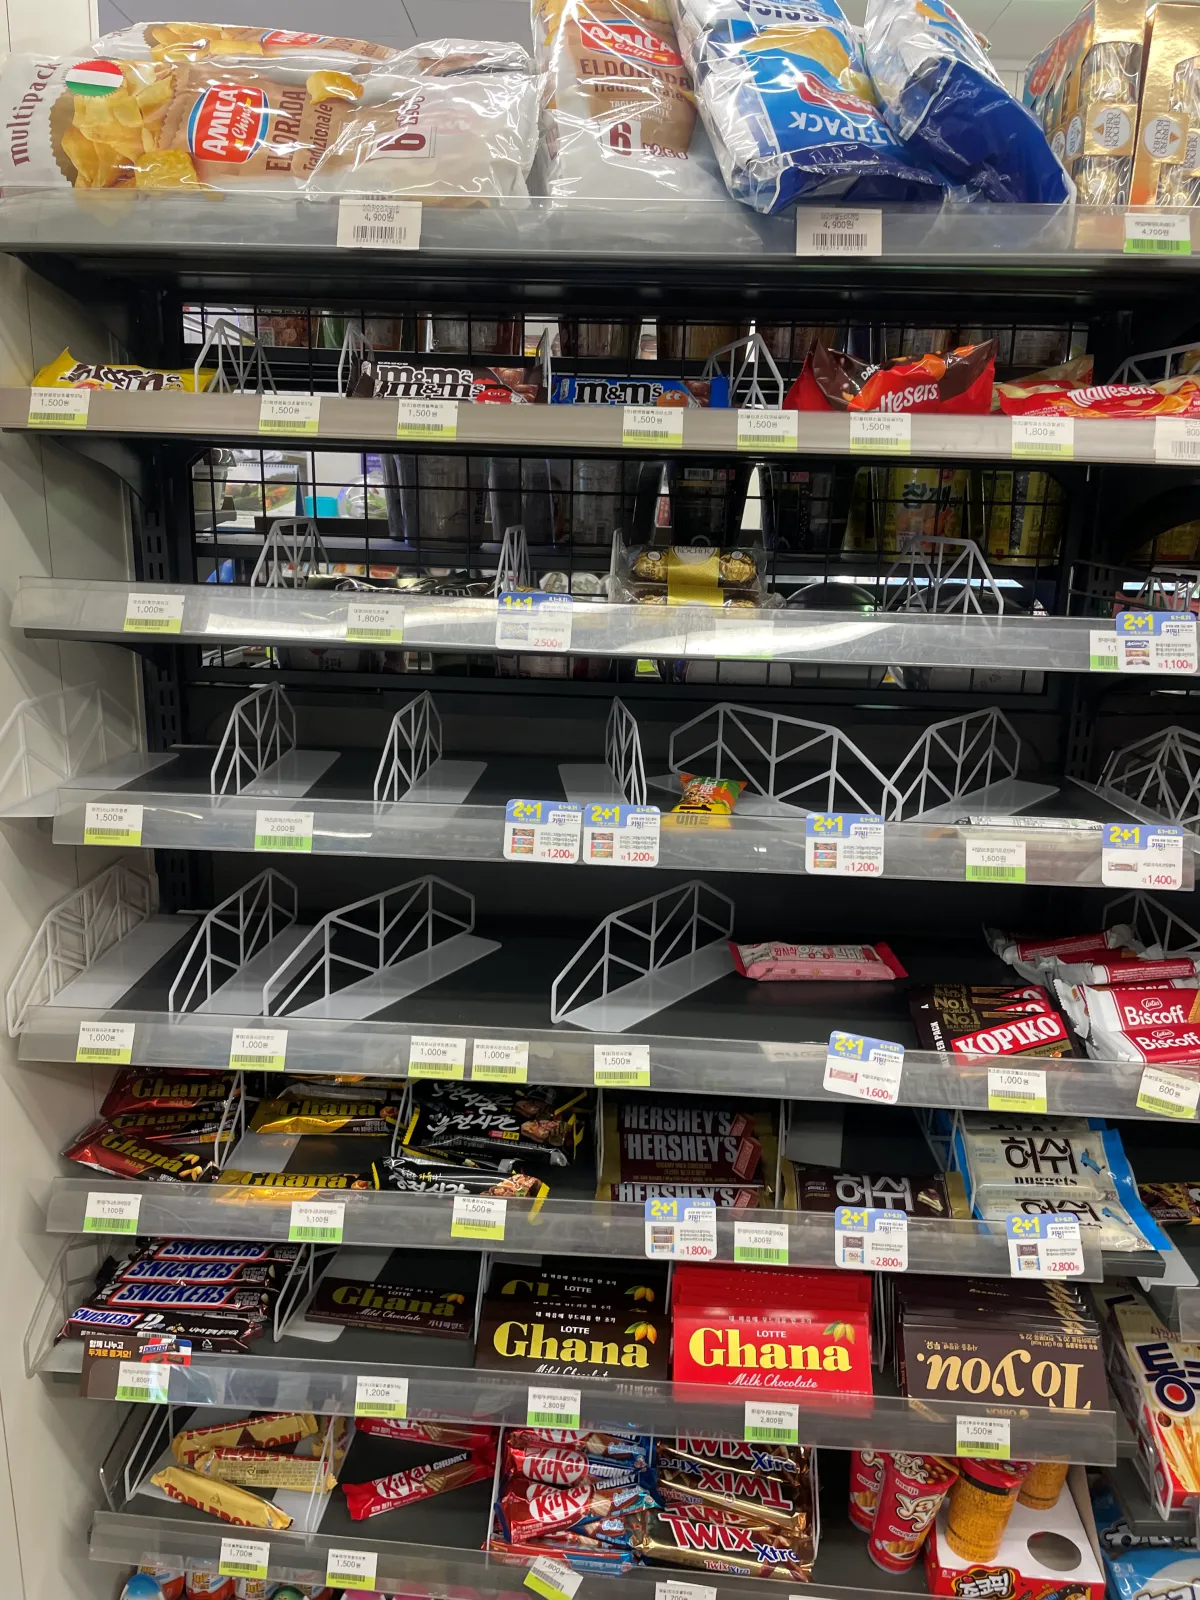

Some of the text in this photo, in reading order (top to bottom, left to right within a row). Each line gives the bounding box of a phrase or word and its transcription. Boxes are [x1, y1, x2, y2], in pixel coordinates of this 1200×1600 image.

[588, 26, 677, 54] AMICA
[6, 62, 62, 167] multipack
[202, 89, 239, 156] AMICA
[265, 90, 307, 172] ELORADA
[1111, 112, 1121, 148] ROCHER
[1152, 118, 1162, 153] ROCHER
[609, 121, 633, 157] 6
[1141, 228, 1170, 237] 4,700원
[376, 365, 474, 384] m&m's
[385, 381, 486, 399] m&m's
[575, 380, 663, 404] m&m's
[40, 398, 69, 408] 1,500원
[270, 406, 300, 415] 1,500원
[408, 409, 438, 418] 1,500원
[633, 416, 663, 425] 1,500원
[749, 421, 778, 429] 1,500원
[861, 423, 891, 431] 1,500원
[1024, 428, 1055, 438] 1,800원
[136, 606, 164, 614] 1,000원
[503, 596, 533, 613] 1+1
[357, 615, 385, 623] 1,800원
[1123, 614, 1154, 630] 2+1
[534, 638, 563, 648] 2,500원
[1164, 660, 1193, 669] 1,100원
[513, 801, 542, 818] 2+1
[591, 805, 620, 822] 2+1
[96, 814, 124, 822] 1,500원
[813, 816, 843, 832] 2+1
[1109, 826, 1140, 843] 2+1
[547, 848, 574, 859] 1,200원
[627, 852, 654, 863] 1,200원
[981, 854, 1007, 863] 1,600원
[851, 862, 880, 873] 1,200원
[1148, 874, 1177, 885] 1,400원
[934, 996, 969, 1009] No.1
[942, 1013, 981, 1026] No.1
[1124, 1005, 1183, 1026] Biscoff
[931, 1021, 943, 1039] PACK
[955, 1016, 1061, 1058] KOPIKO
[89, 1034, 115, 1042] 1,000원
[241, 1041, 268, 1049] 1,000원
[834, 1035, 864, 1055] 2+1
[1136, 1032, 1200, 1050] Biscoff
[420, 1048, 447, 1057] 1,000원
[483, 1051, 511, 1059] 1,000원
[604, 1057, 631, 1065] 1,500원
[1000, 1076, 1029, 1085] 1,000원
[132, 1077, 226, 1099] Ghana
[865, 1087, 894, 1101] 1,600원
[1158, 1085, 1181, 1098] 600원
[280, 1101, 376, 1117] Ghana
[624, 1105, 731, 1136] HERSHEY'S
[101, 1133, 185, 1173] Ghana
[627, 1134, 739, 1163] HERSHEY'S
[1001, 1137, 1079, 1175] 허쉬
[241, 1172, 348, 1189] Ghana
[1014, 1176, 1078, 1187] nuggets
[833, 1174, 914, 1211] 허쉬
[101, 1206, 124, 1215] 1,100원
[465, 1203, 492, 1214] 1,500원
[651, 1199, 678, 1217] 2+1
[306, 1216, 329, 1224] 1,100원
[841, 1209, 868, 1225] 2+1
[1012, 1216, 1040, 1233] 2+1
[748, 1236, 772, 1244] 1,800원
[163, 1240, 267, 1257] SNICKERS
[685, 1246, 712, 1256] 1,800원
[875, 1257, 903, 1267] 2,800원
[1051, 1262, 1080, 1272] 2,800원
[131, 1260, 240, 1279] SNICKERS
[119, 1284, 231, 1303] SNICKERS
[564, 1285, 592, 1294] LOTTE
[332, 1286, 455, 1317] Ghana
[72, 1308, 136, 1327] SNICKERS
[356, 1308, 421, 1322] Mild Chocolate
[560, 1325, 590, 1335] LOTTE
[756, 1330, 786, 1338] LOTTE
[89, 1340, 124, 1349] 함께 나누고
[144, 1343, 167, 1354] SNICKERS
[493, 1321, 649, 1368] Ghana
[689, 1327, 852, 1372] Ghana
[88, 1349, 108, 1357] 두개로
[534, 1363, 561, 1376] Mild
[728, 1373, 818, 1388] Milk Chocolate
[916, 1350, 1092, 1414] To you.
[365, 1388, 390, 1397] 1,200원
[543, 1402, 566, 1410] 2,800원
[986, 1408, 1017, 1417] ORION
[760, 1416, 783, 1424] 2,800원
[966, 1427, 993, 1435] 1,500원
[433, 1452, 467, 1471] CHUNKY
[529, 1448, 583, 1484] KitKat
[752, 1452, 797, 1472] Xtra
[590, 1463, 632, 1480] CHUNKY
[380, 1465, 431, 1498] KitKat
[596, 1473, 637, 1490] CHUNKY
[895, 1478, 919, 1495] meiji
[659, 1487, 682, 1499] Twix
[699, 1468, 792, 1510] TWIX
[535, 1484, 588, 1521] KitKat
[659, 1513, 755, 1550] TWIX
[336, 1560, 361, 1569] 1,500원
[704, 1560, 750, 1574] Twix Xtra
